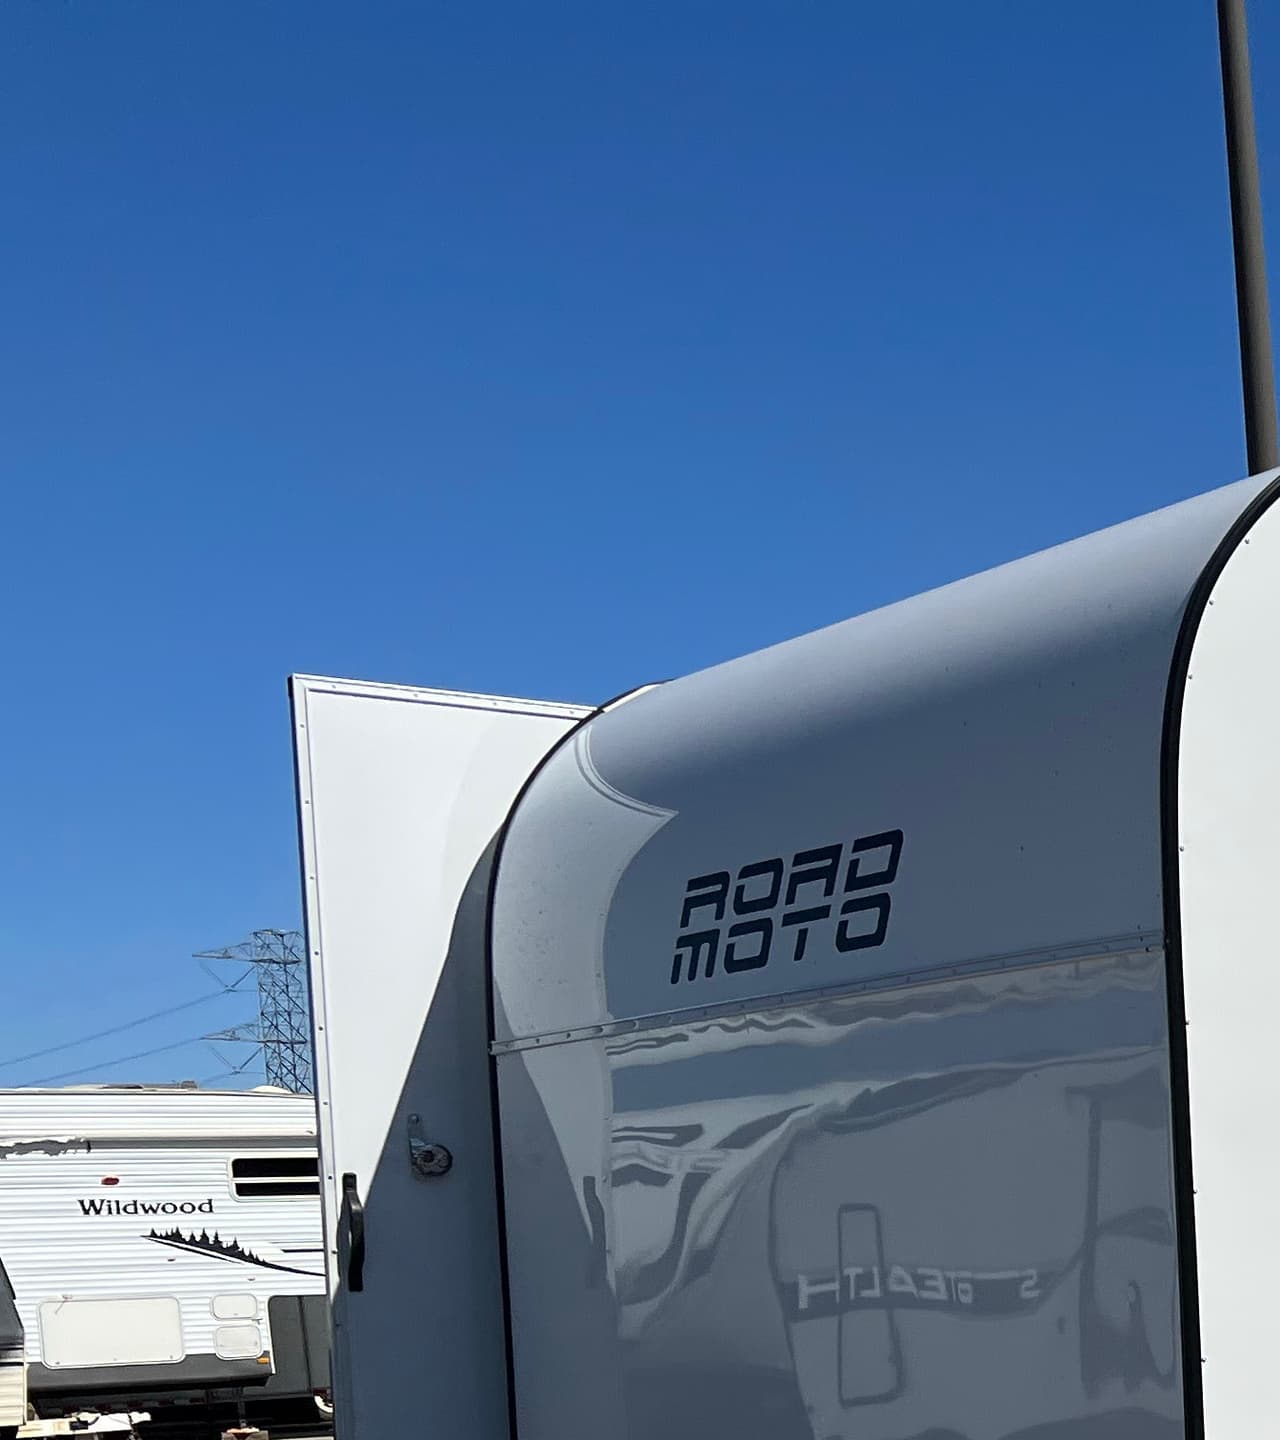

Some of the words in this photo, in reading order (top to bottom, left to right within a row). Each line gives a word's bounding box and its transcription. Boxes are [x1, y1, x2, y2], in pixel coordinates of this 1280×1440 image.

[680, 828, 904, 928] ROAD
[670, 892, 891, 985] MOTO
[77, 1198, 214, 1216] Wildwood
